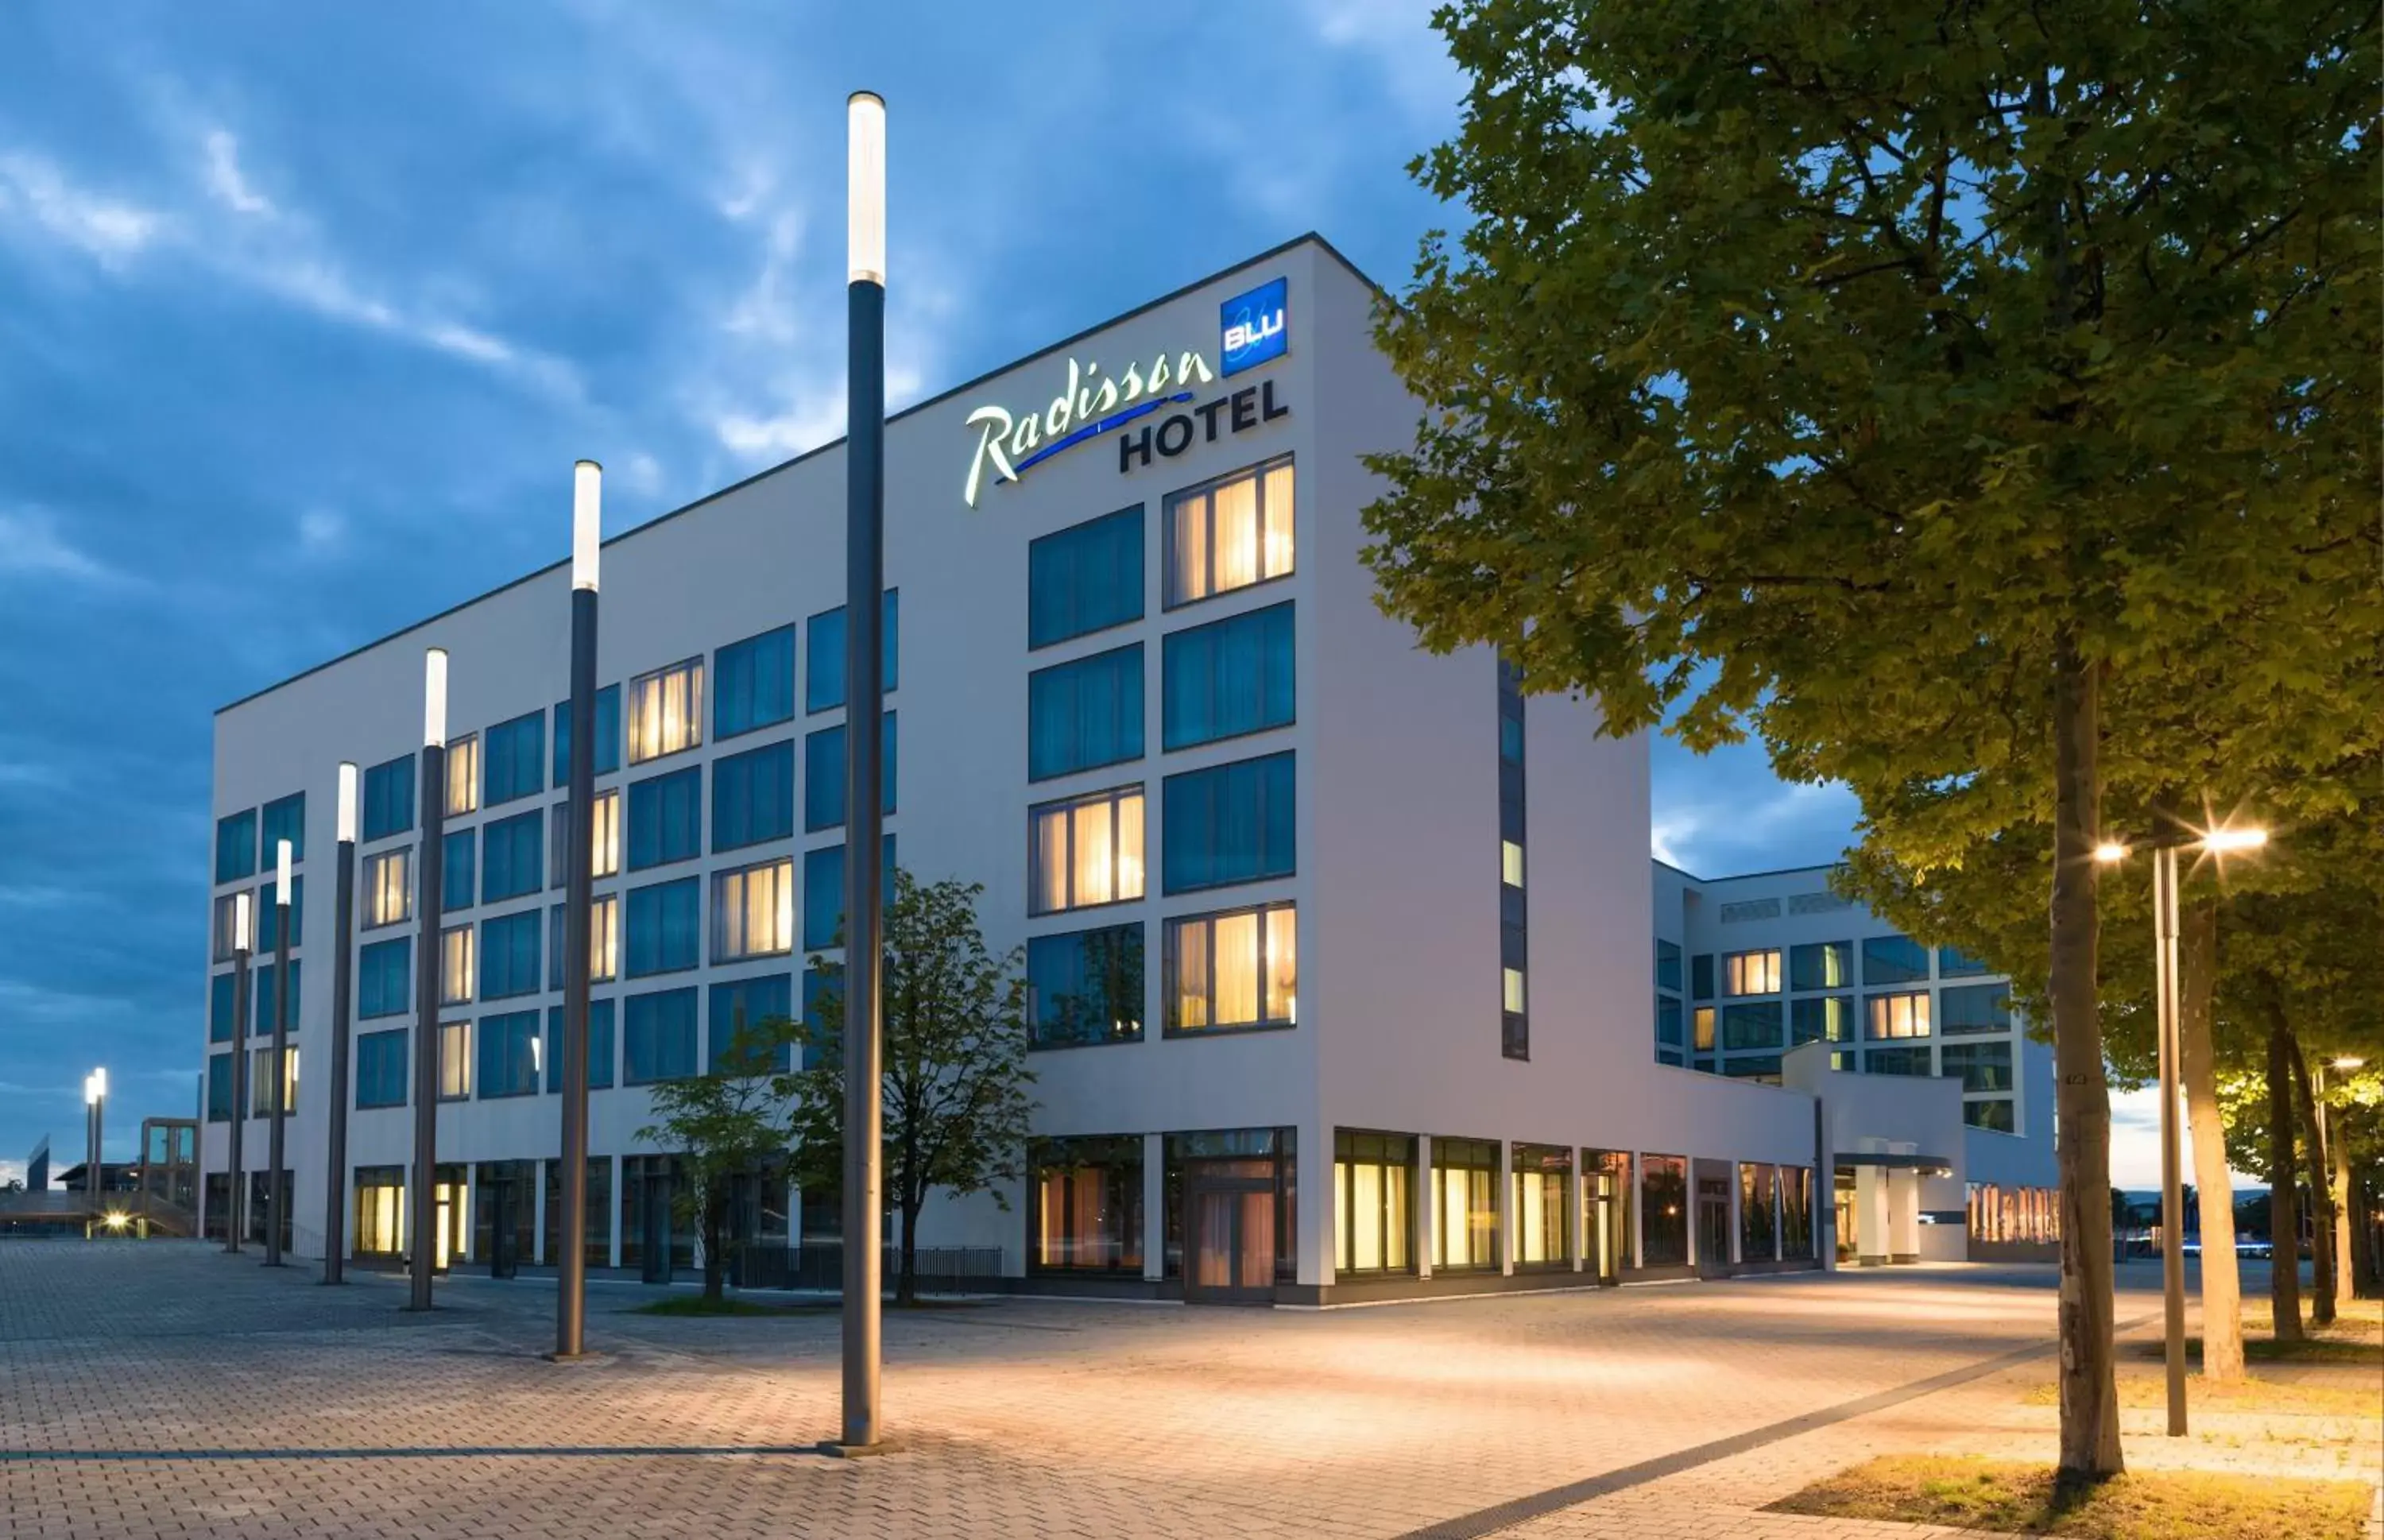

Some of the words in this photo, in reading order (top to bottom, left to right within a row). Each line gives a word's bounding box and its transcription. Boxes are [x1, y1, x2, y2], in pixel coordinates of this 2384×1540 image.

[964, 350, 1213, 507] Radisson
[1224, 308, 1283, 352] BLU
[1119, 378, 1289, 474] HOTEL
